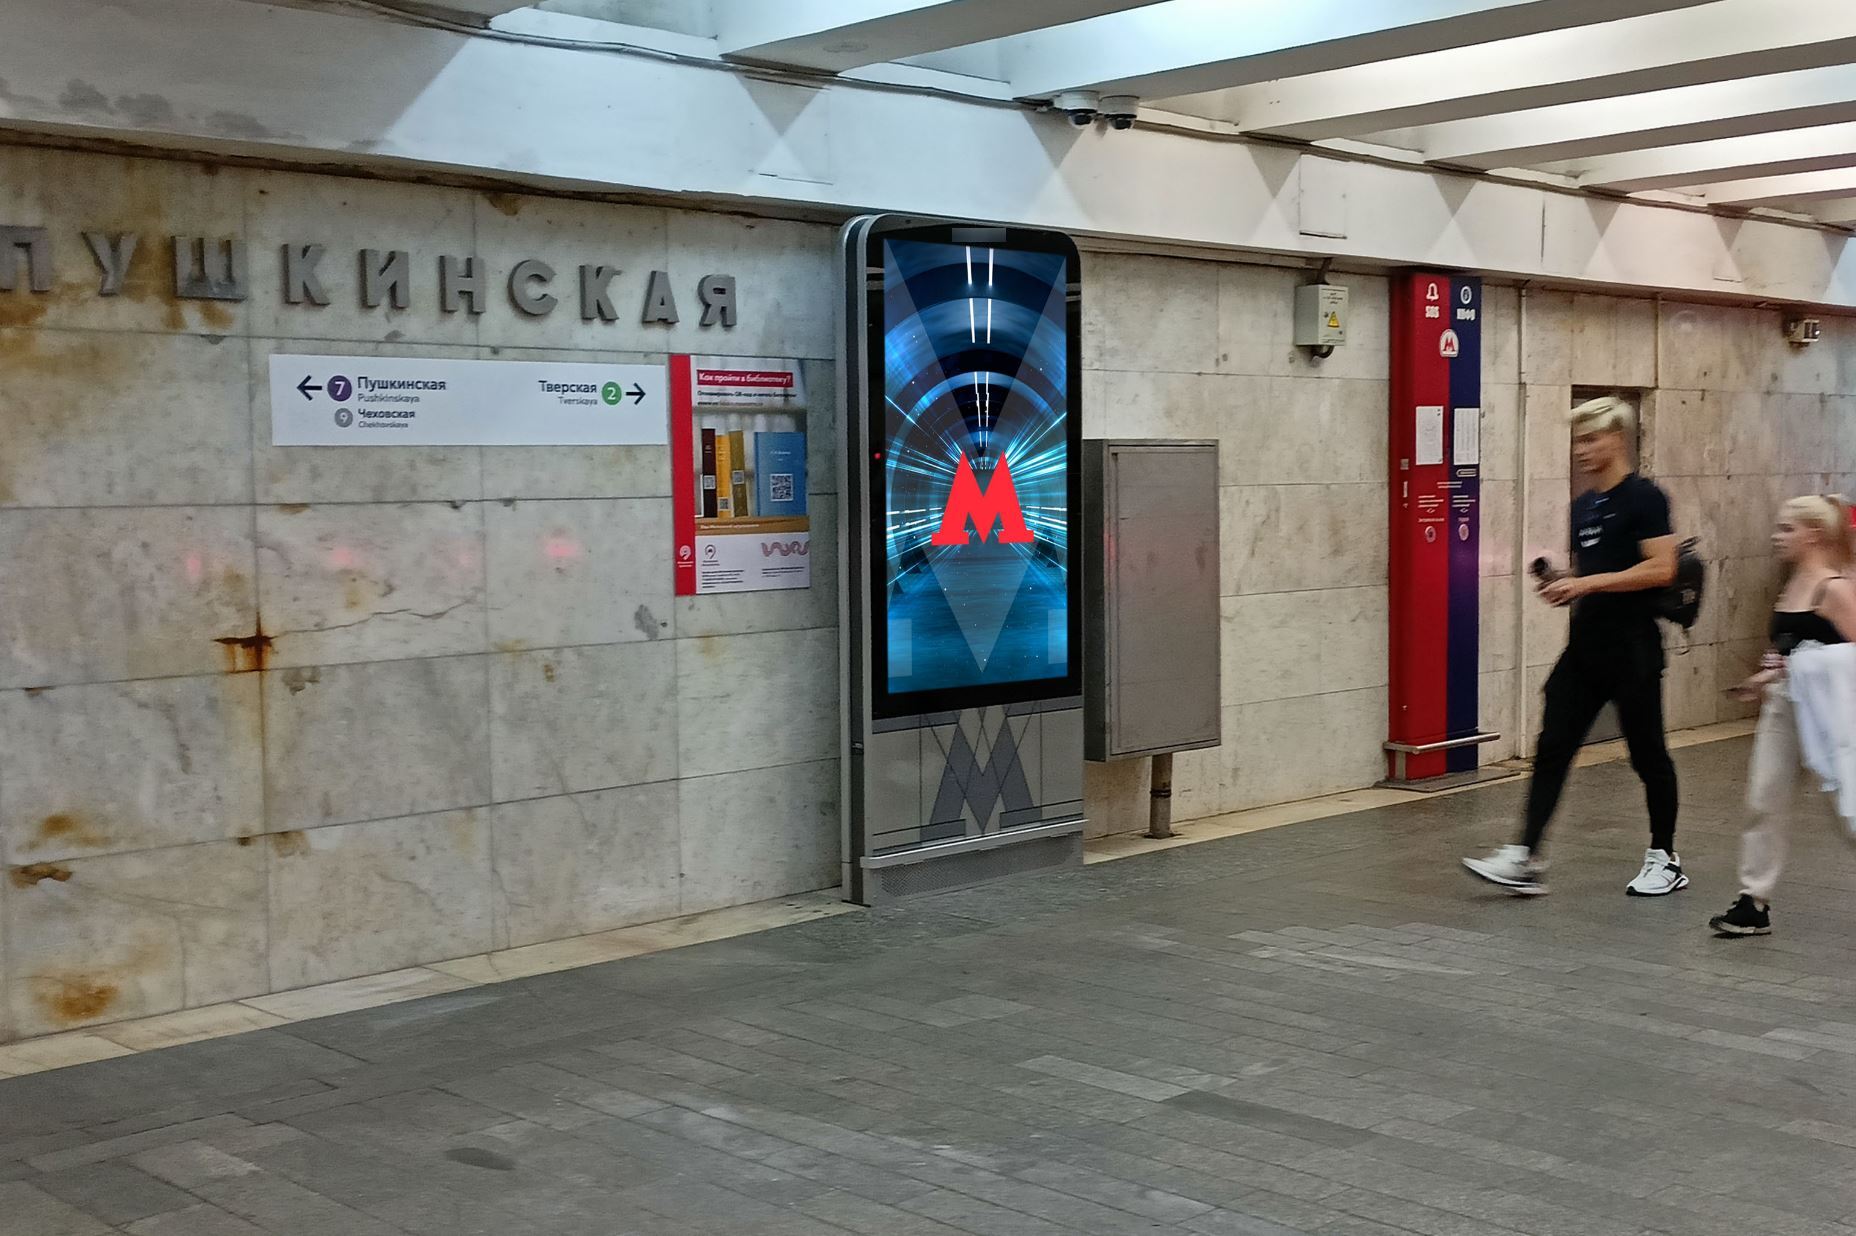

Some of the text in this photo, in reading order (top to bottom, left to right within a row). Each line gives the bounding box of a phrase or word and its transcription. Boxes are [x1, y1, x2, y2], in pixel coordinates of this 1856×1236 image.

[0, 225, 737, 327] ПУШКИНСКАЯ
[334, 376, 447, 396] 7 Пушкинская
[538, 380, 598, 395] Тверская
[357, 393, 420, 403] Pushkinskaya
[557, 396, 598, 406] Tverskaya
[357, 408, 416, 419] Чеховская
